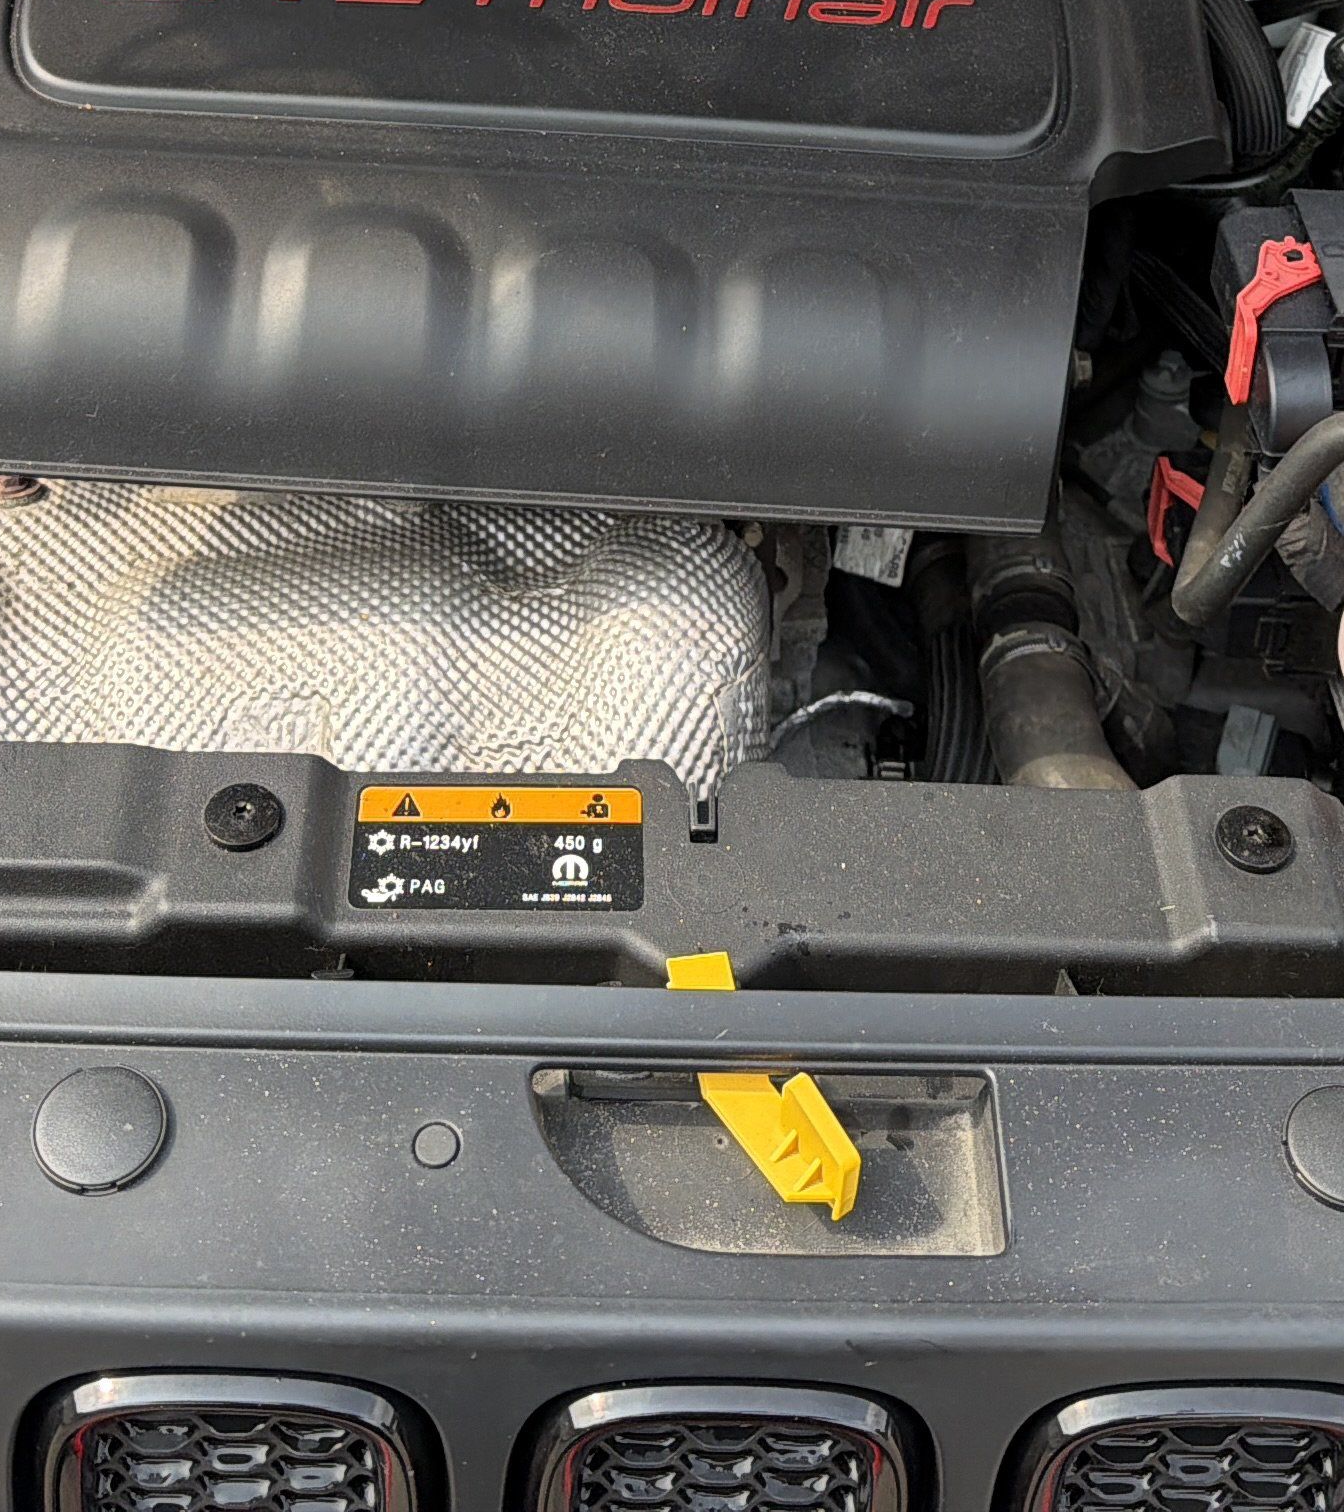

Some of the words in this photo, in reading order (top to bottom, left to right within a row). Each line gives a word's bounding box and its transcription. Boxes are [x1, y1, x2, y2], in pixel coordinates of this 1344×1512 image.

[399, 834, 480, 854] R-1234yf
[553, 835, 586, 851] 450
[592, 838, 603, 854] g
[409, 878, 447, 895] PAG
